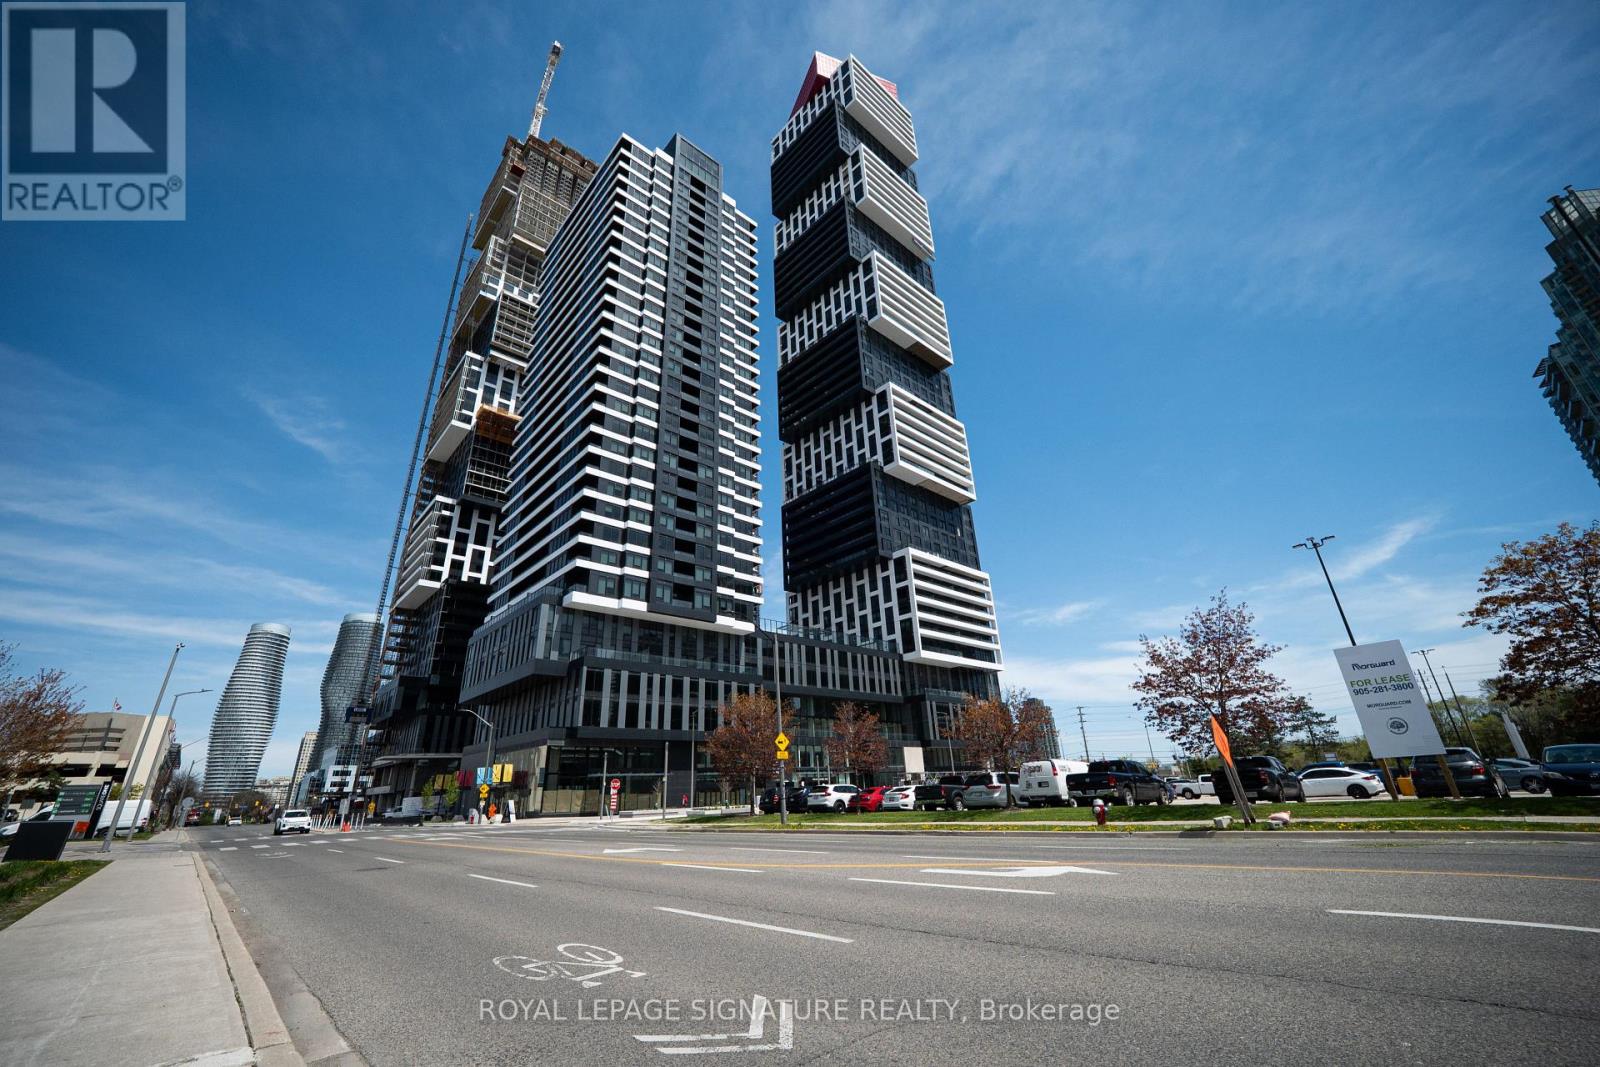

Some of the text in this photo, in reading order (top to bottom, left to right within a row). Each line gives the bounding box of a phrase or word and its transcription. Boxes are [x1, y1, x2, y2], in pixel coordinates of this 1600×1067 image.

[1350, 673, 1411, 688] FOR LEASE
[1353, 682, 1414, 696] 905-281-3800
